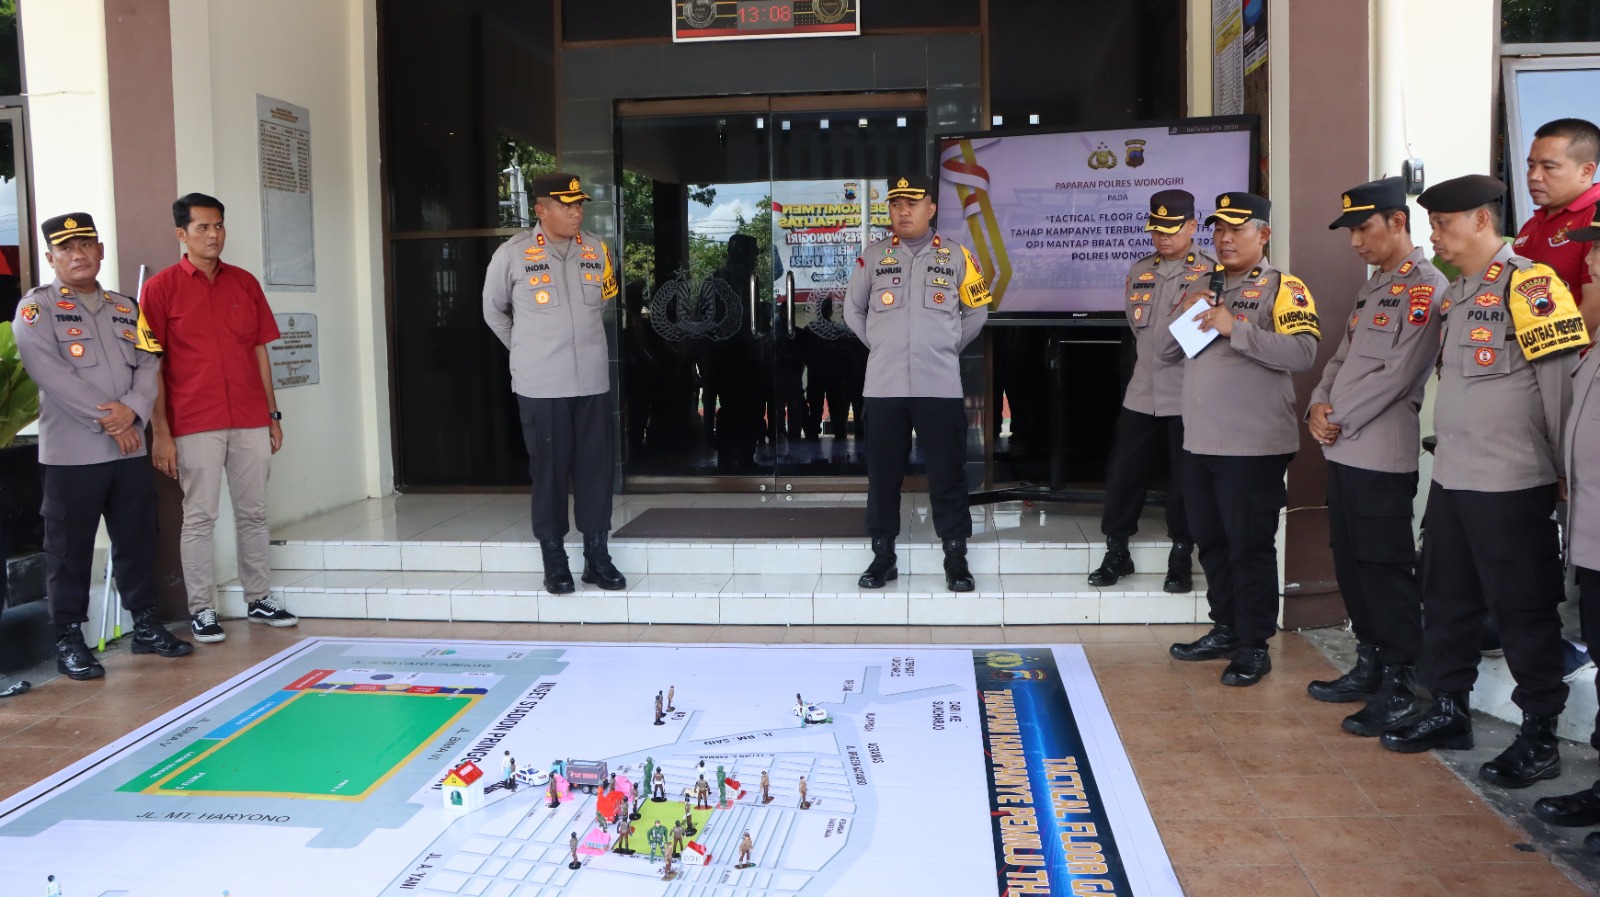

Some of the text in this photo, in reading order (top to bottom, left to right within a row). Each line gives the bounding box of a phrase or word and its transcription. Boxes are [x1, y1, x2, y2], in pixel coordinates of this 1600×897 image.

[1055, 177, 1184, 190] PAPARAN POLRES WONOGIRI
[1100, 213, 1132, 222] FLOOR
[1011, 228, 1043, 237] TAHAP
[1046, 227, 1102, 236] KAMPANYE
[1104, 225, 1145, 234] TERBUK
[1026, 240, 1044, 248] OPS
[1046, 240, 1089, 248] MANTAP
[1092, 238, 1124, 247] BRATA
[1072, 252, 1109, 261] POLRES
[524, 264, 550, 272] INDRA
[580, 262, 602, 270] POLRI
[876, 266, 902, 277] SANUSI
[928, 266, 954, 276] POLRI
[1232, 300, 1260, 310] POLRI
[1378, 298, 1400, 308] POLRI
[55, 314, 82, 322] TEGUH
[1467, 310, 1504, 322] POLRI
[1520, 324, 1554, 348] KASATGAS
[1540, 340, 1557, 350] CANDI
[525, 682, 558, 700] INSET
[494, 701, 538, 732] STADION
[983, 688, 1020, 735] TAHAPAN
[704, 738, 730, 746] SAID
[988, 734, 1034, 806] KAMPANYE
[1042, 756, 1092, 818] TACTICAL
[198, 812, 291, 822] HARYONO
[998, 806, 1046, 867] PEMILU
[1060, 820, 1109, 876] FLOOR
[399, 871, 427, 890] YANI
